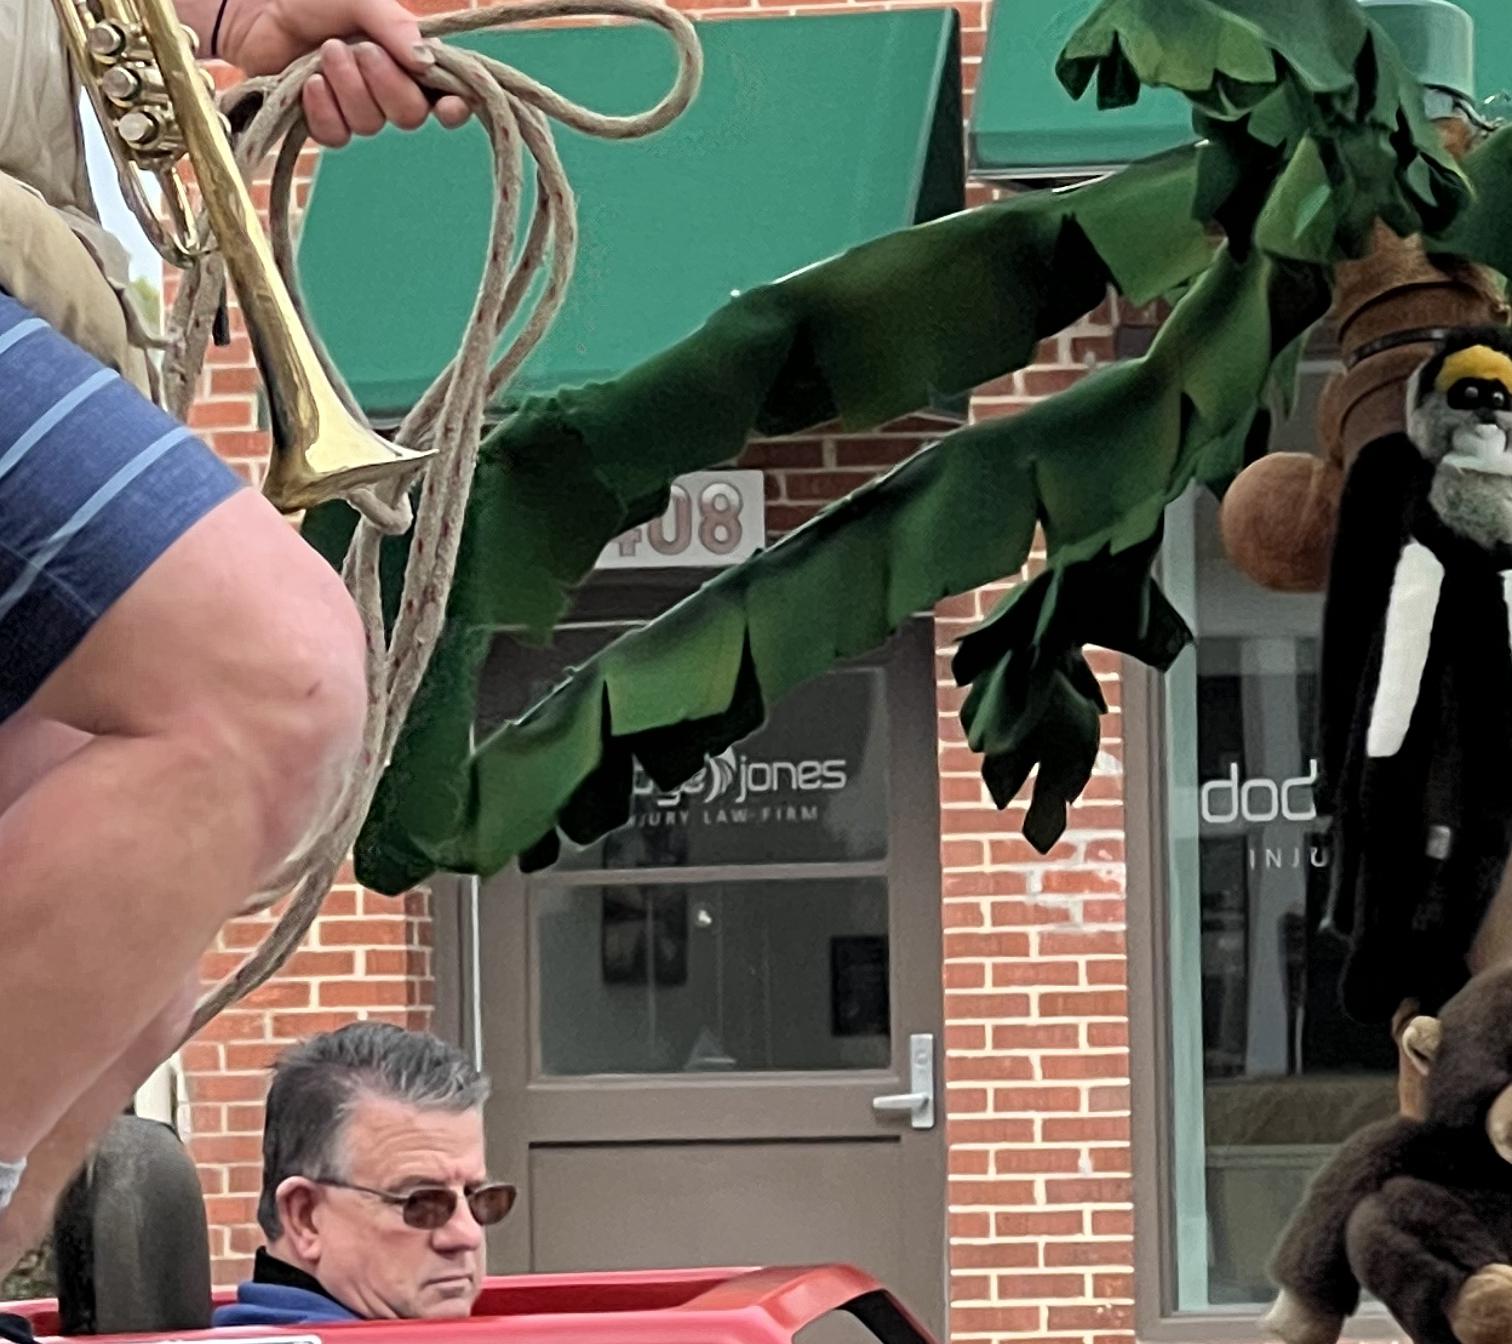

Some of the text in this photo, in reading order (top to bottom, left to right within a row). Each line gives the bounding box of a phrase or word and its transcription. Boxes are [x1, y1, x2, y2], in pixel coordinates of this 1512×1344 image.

[736, 756, 846, 803] jones
[703, 808, 748, 825] LAW
[762, 805, 818, 822] FIRM
